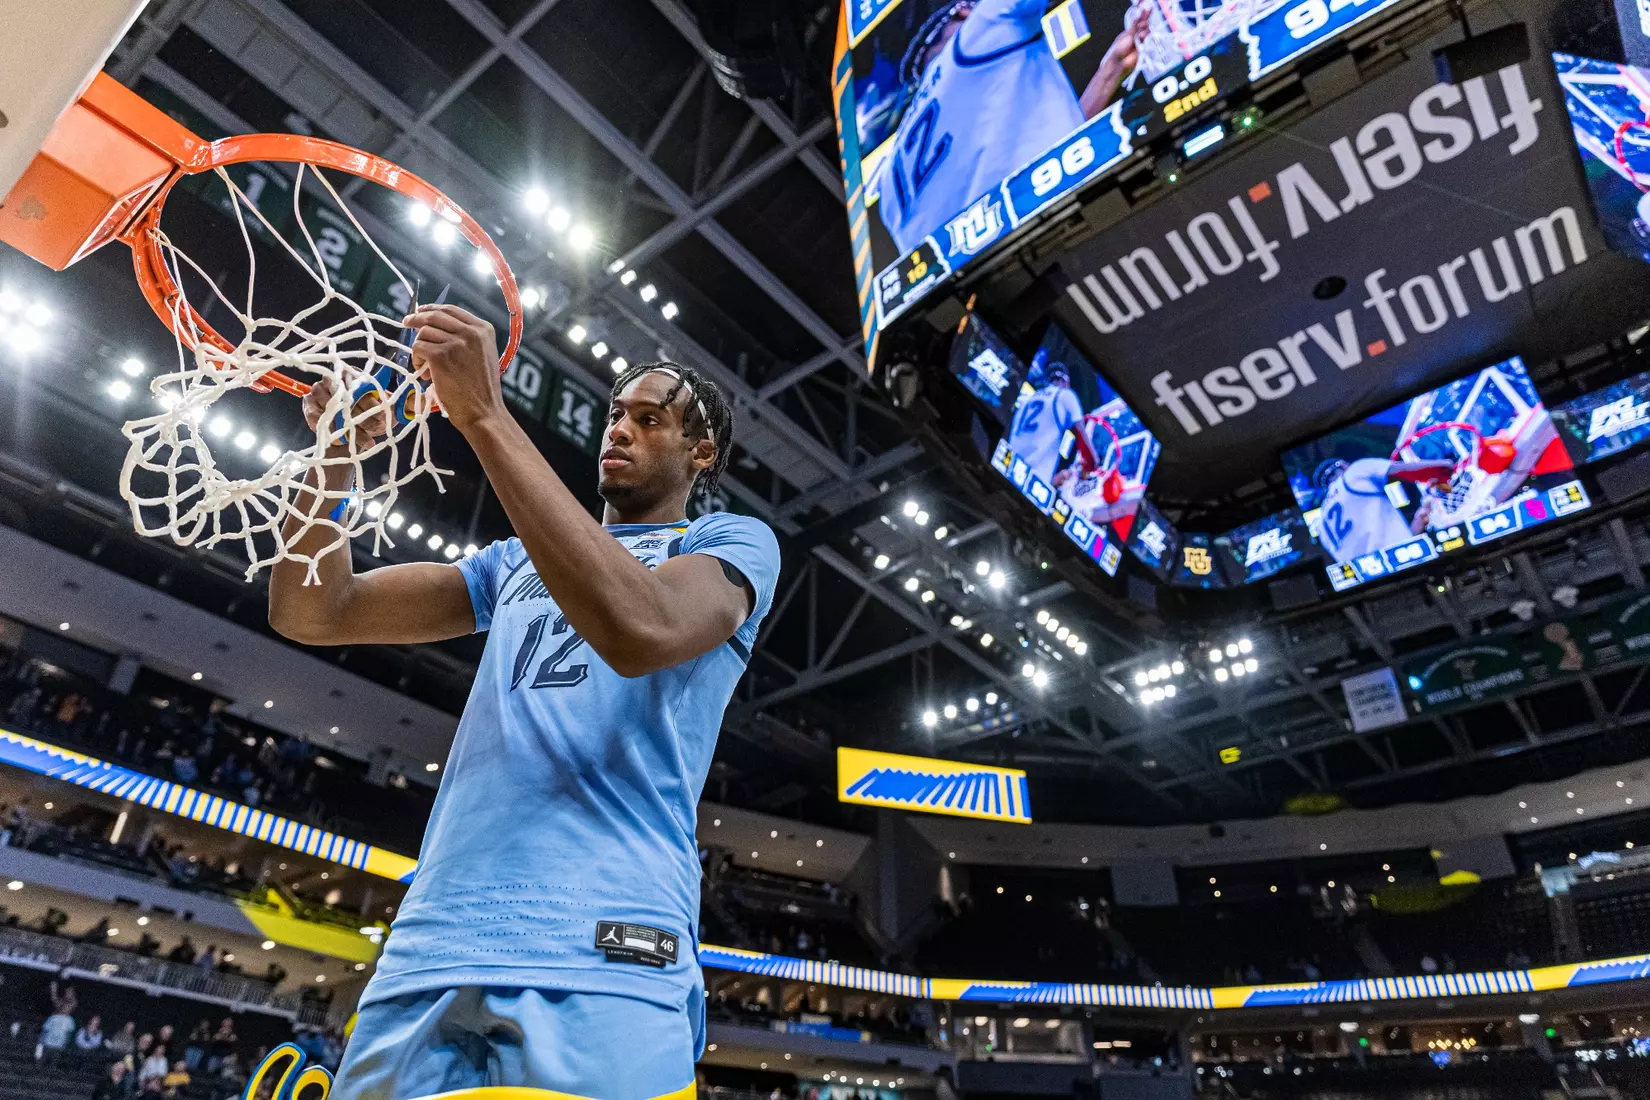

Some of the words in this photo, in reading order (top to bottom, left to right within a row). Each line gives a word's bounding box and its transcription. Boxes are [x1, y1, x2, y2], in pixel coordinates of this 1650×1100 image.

[1152, 56, 1212, 103] 0.0
[1163, 77, 1218, 123] 2nd
[893, 98, 953, 229] 12
[1031, 136, 1095, 197] 96
[240, 172, 267, 210] 1
[316, 227, 349, 269] 2
[945, 194, 1004, 257] MU
[907, 261, 927, 283] 10
[1150, 206, 1588, 436] fiserv.forum
[501, 354, 541, 398] 10
[557, 390, 592, 437] 14
[1017, 400, 1044, 434] 12
[1324, 502, 1353, 550] 12
[1184, 547, 1212, 575] MU
[510, 613, 588, 692] 12
[660, 939, 674, 952] 46
